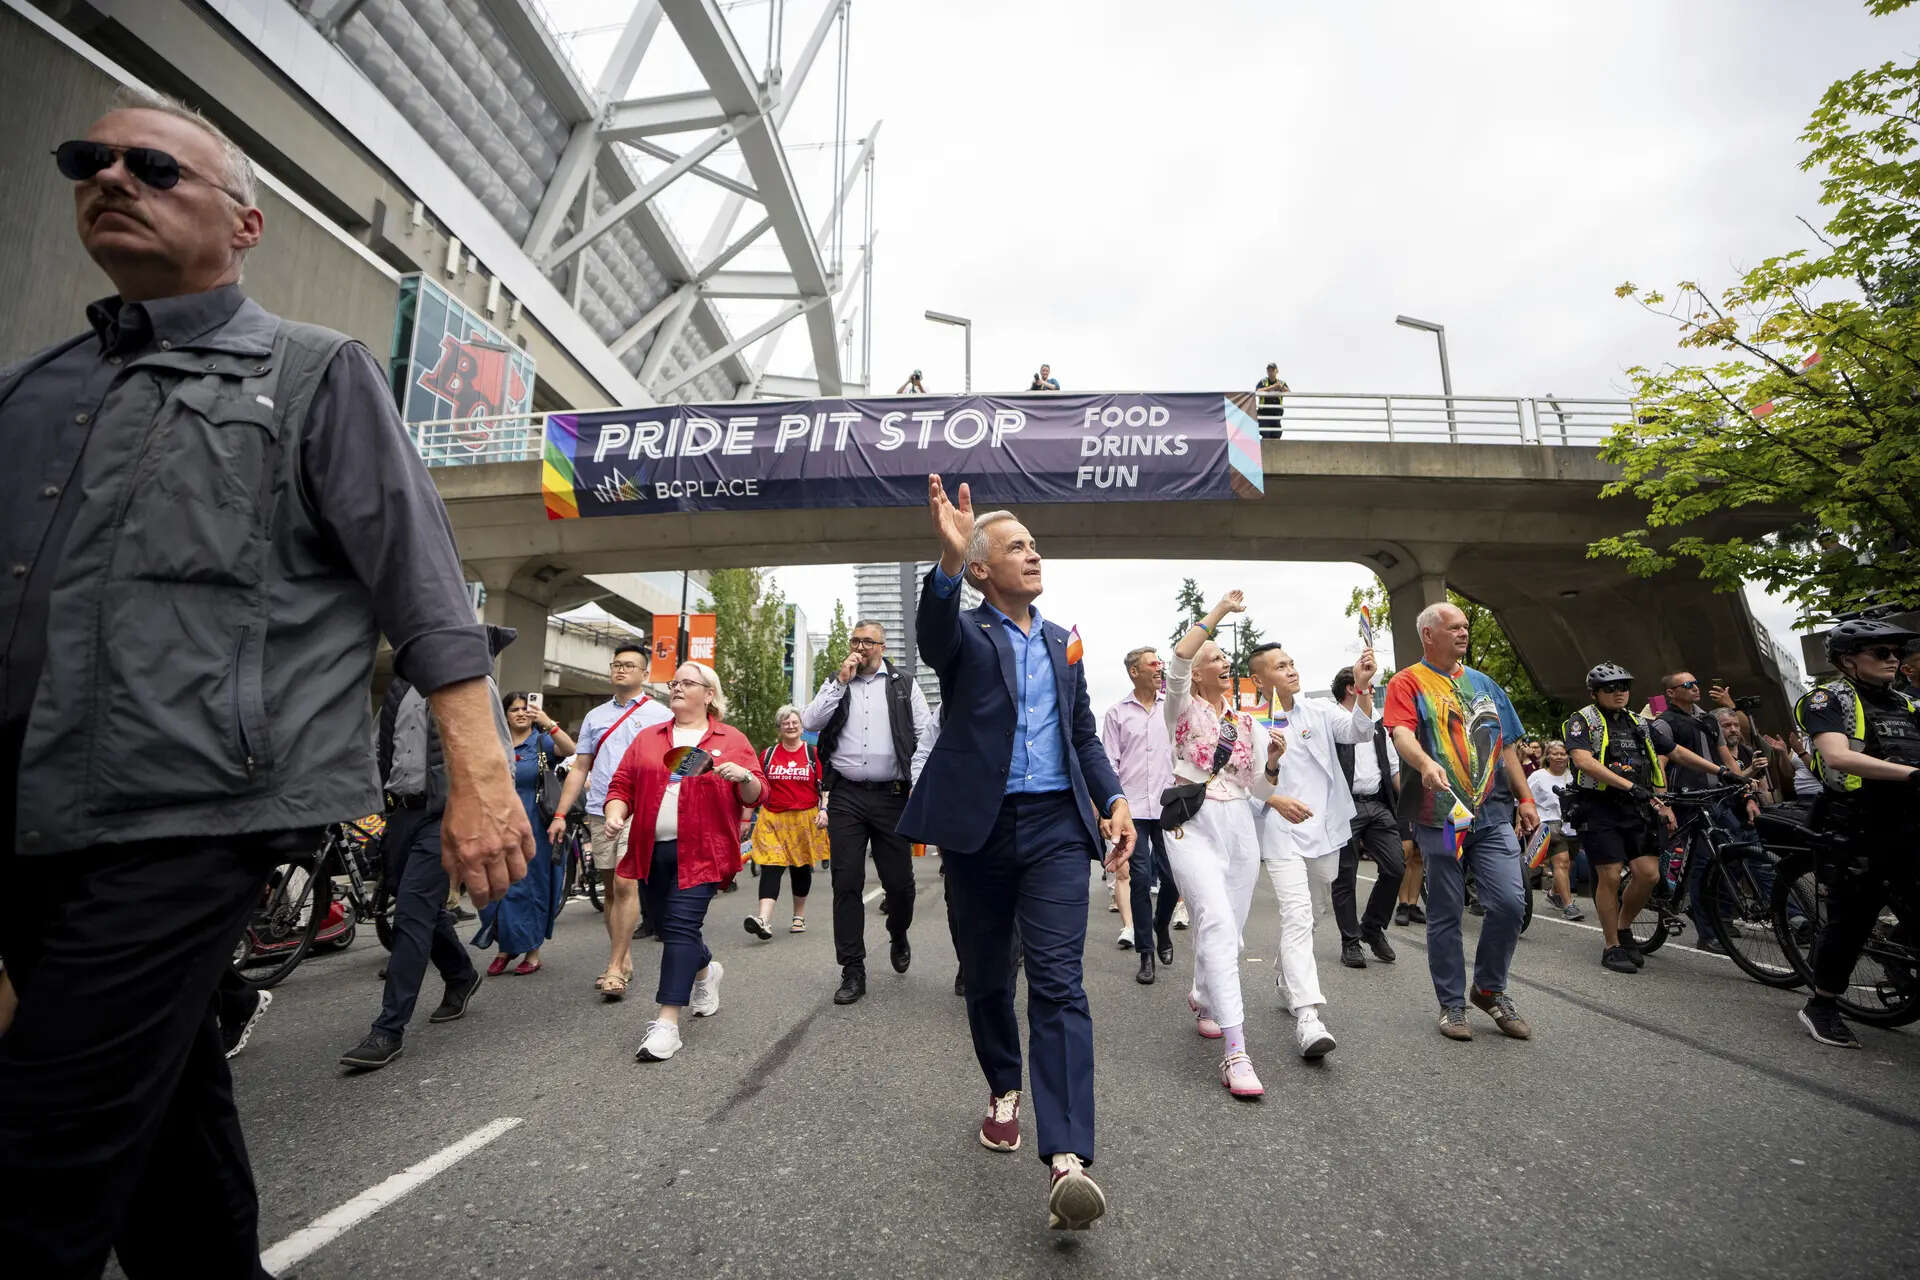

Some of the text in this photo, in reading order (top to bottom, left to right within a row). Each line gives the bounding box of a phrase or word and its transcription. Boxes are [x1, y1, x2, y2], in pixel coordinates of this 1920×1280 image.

[1083, 406, 1170, 428] FOOD
[593, 408, 1027, 463] PRIDE PIT STOP
[1080, 434, 1189, 457] DRINKS
[1076, 465, 1139, 489] FUN
[690, 646, 713, 659] ONE
[769, 765, 809, 776] Liberal
